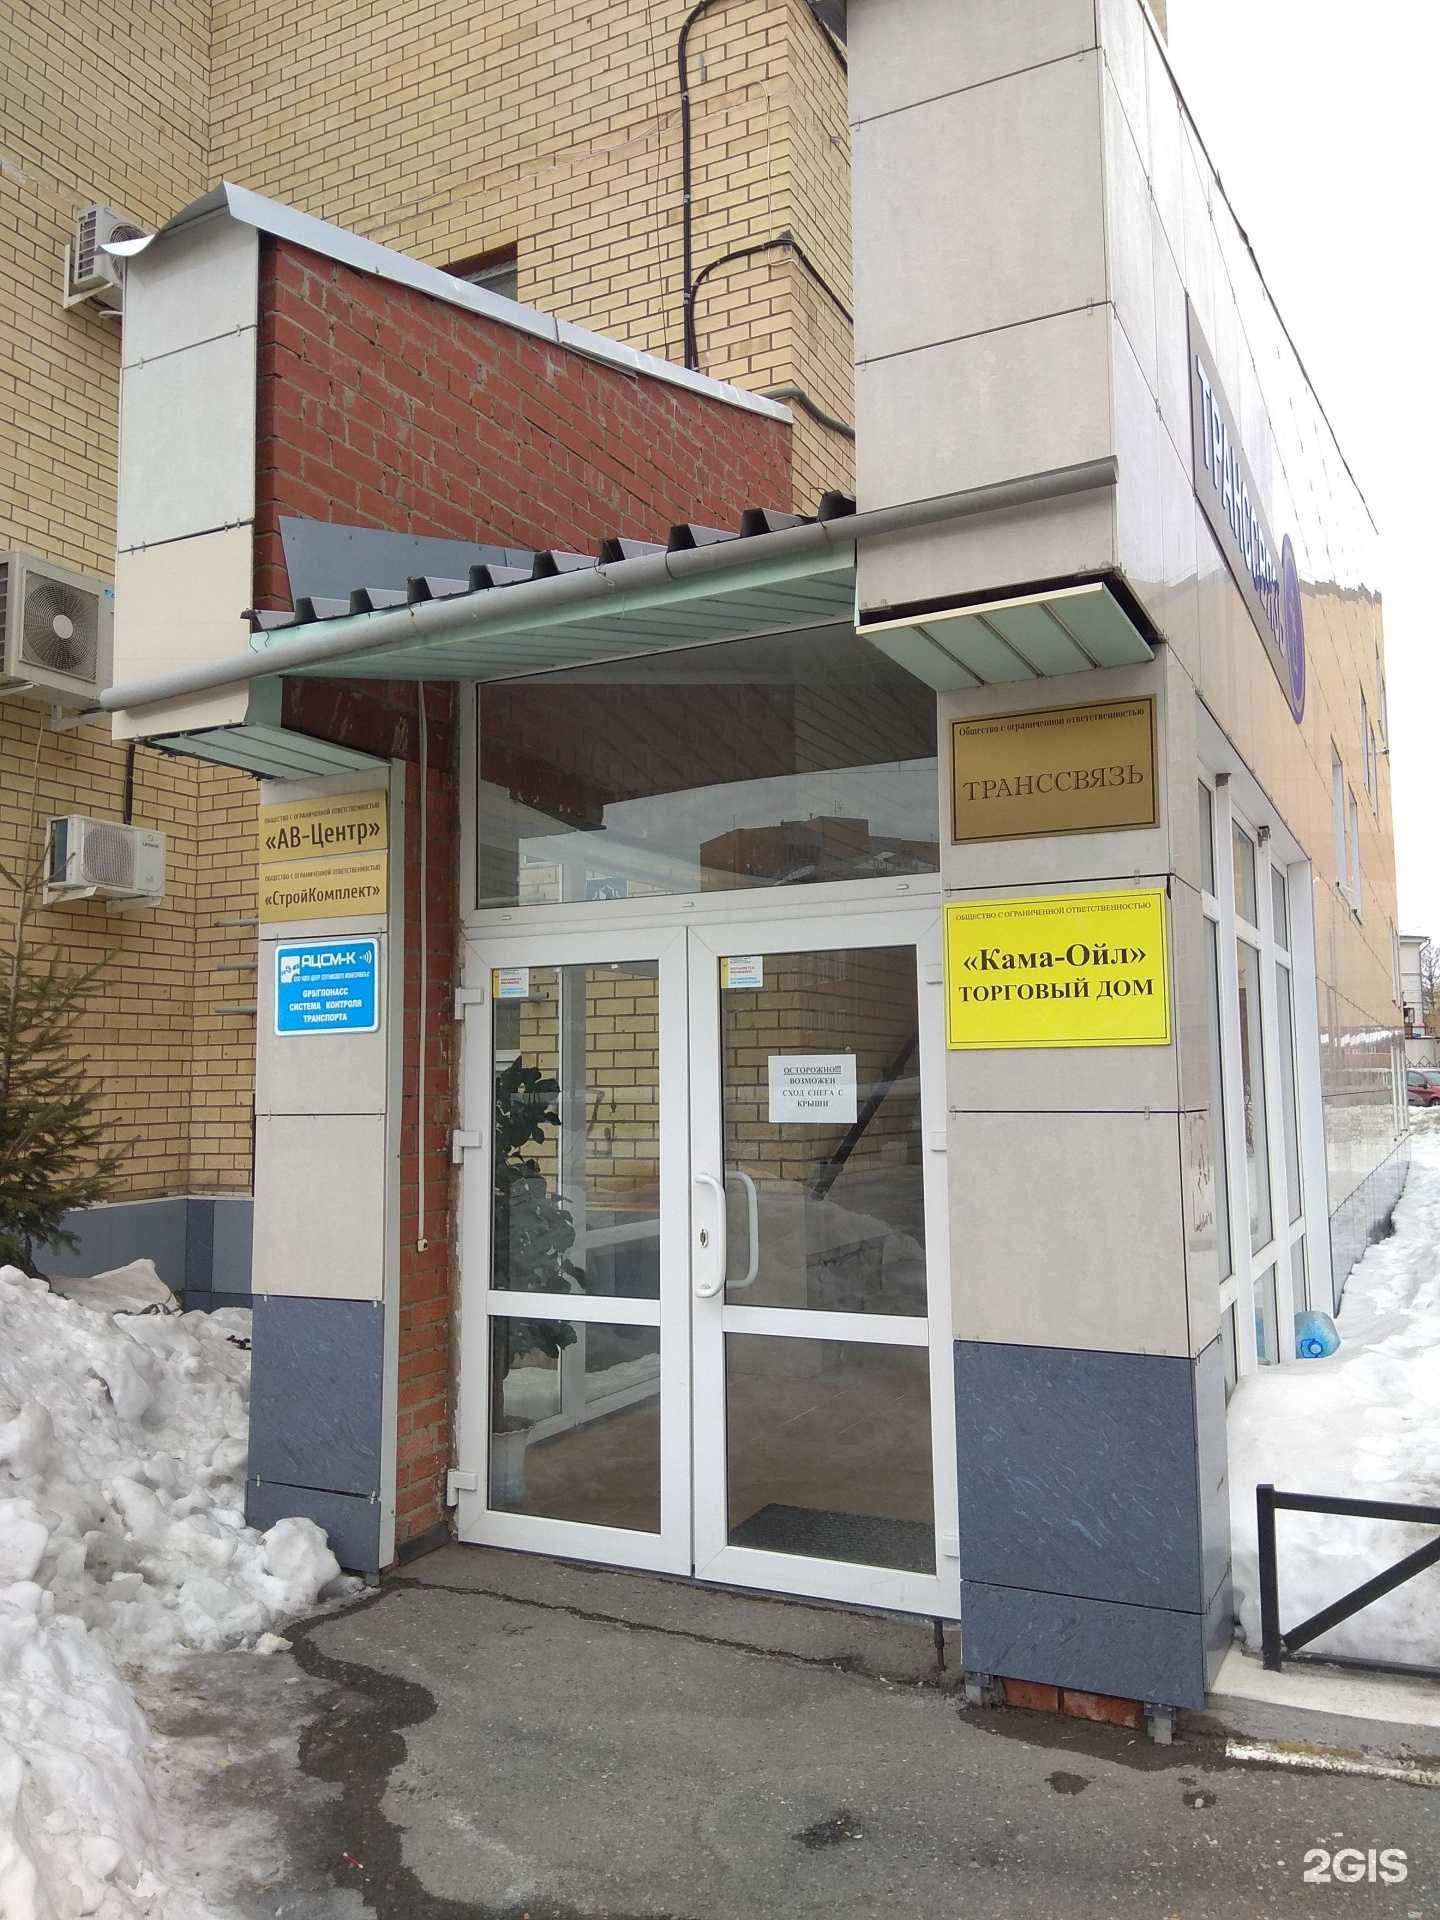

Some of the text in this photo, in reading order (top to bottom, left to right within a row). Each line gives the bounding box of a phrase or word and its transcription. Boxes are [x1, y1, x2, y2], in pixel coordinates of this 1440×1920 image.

[959, 708, 1145, 737] Общество с ограниченной ответственностью
[962, 764, 1145, 801] ТРАНССВЯЗЬ
[265, 822, 380, 850] «АВ-Центр»
[265, 885, 380, 908] «СтройКомплект»
[955, 911, 997, 921] ОБЩЕСТВО
[1004, 906, 1065, 918] ОГРАНИЧЕННОЙ
[1066, 901, 1152, 914] ОТВЕТСТВЕННОСТЬЮ
[301, 951, 357, 969] АЦСМ-К
[963, 942, 1146, 971] «Кама-Ойл»
[958, 977, 1153, 1002] ТОРГОВЫЙ ДОМ
[289, 999, 362, 1011] СИСТЕМА КОНТРОЛЯ
[303, 1013, 348, 1023] ТРАНСПОРТА
[789, 1077, 836, 1085] ВОЗМОЖЕН
[782, 1089, 805, 1097] СХОД
[807, 1089, 834, 1097] СНЕГА
[797, 1099, 829, 1107] КРЫШИ
